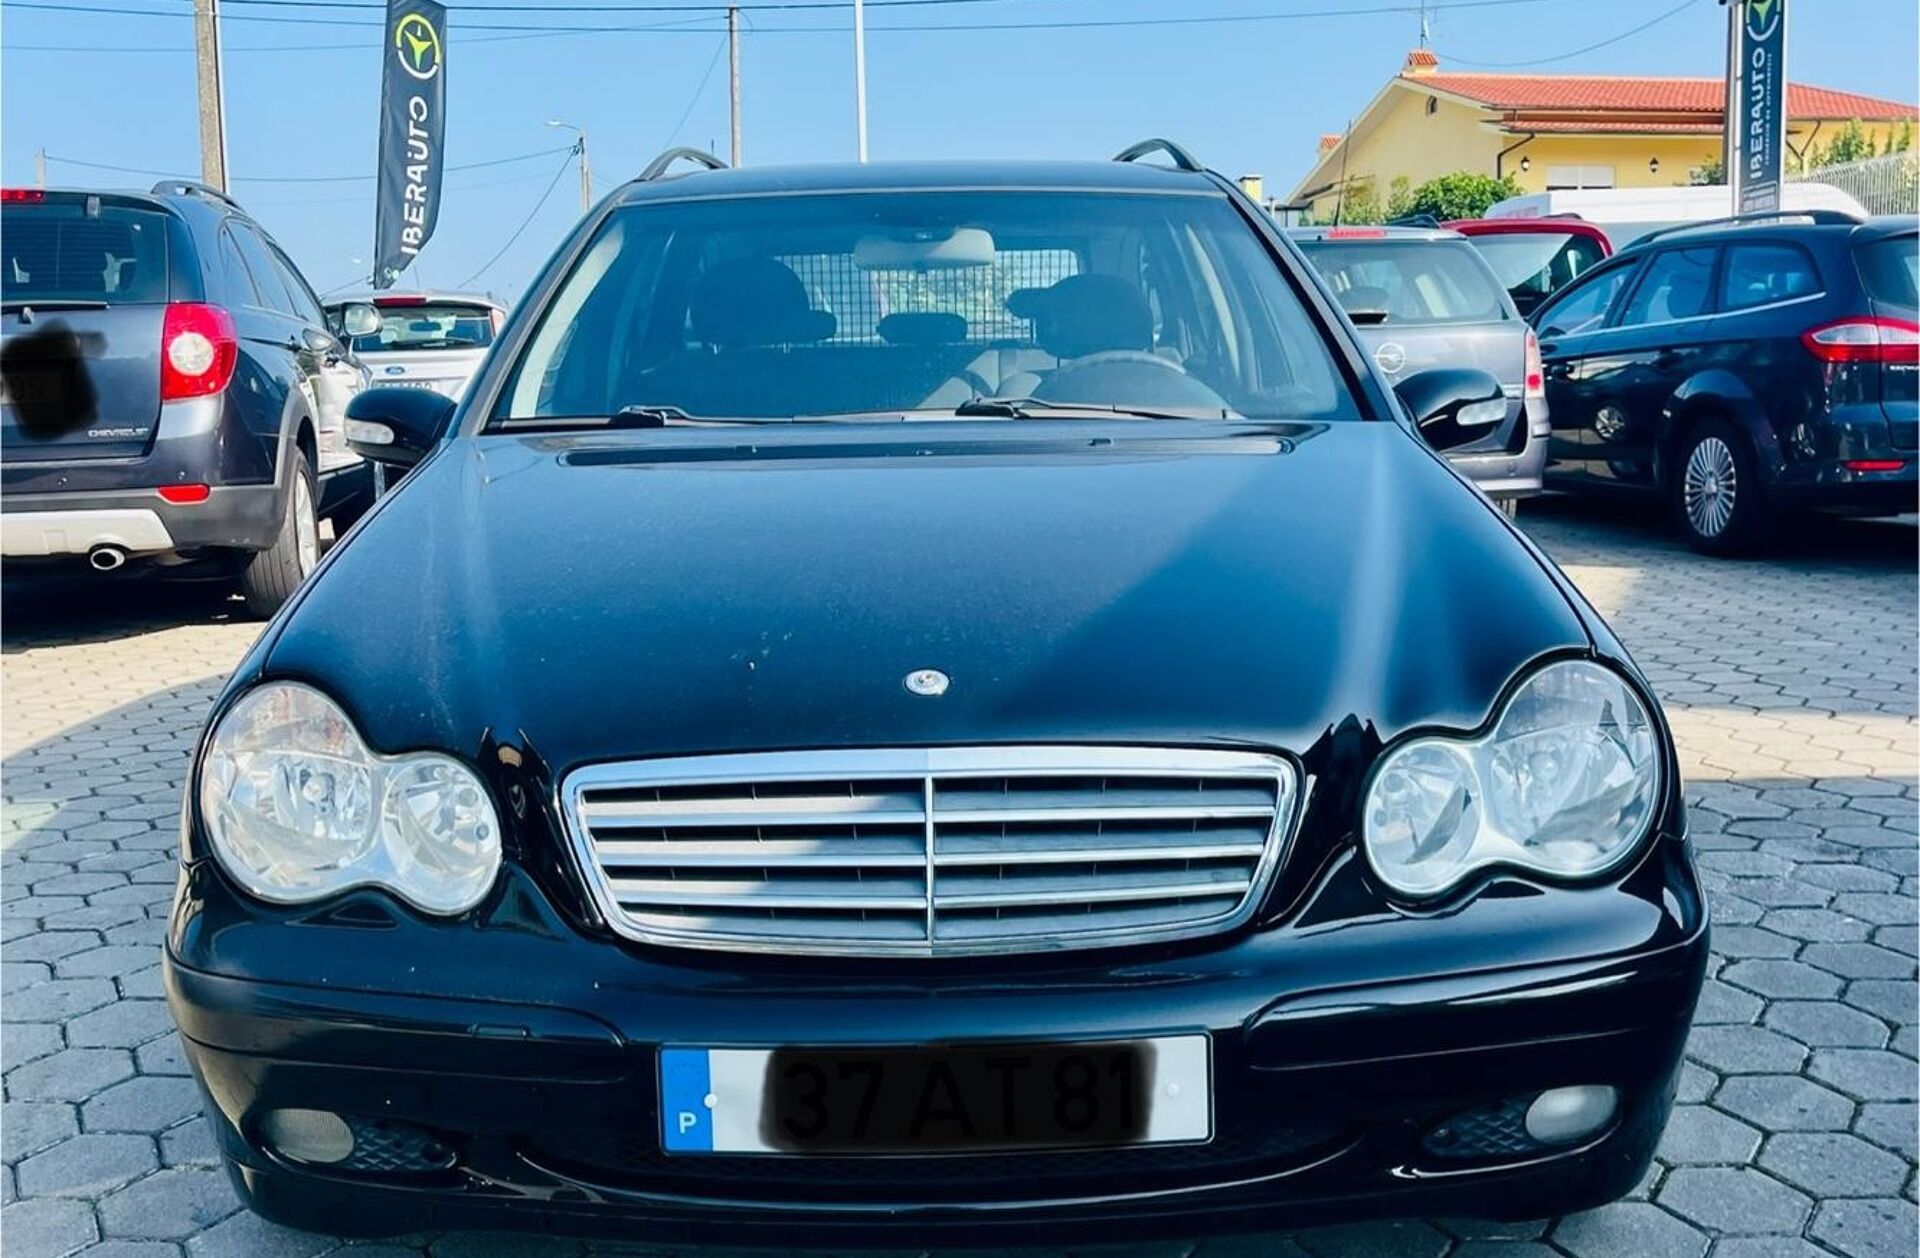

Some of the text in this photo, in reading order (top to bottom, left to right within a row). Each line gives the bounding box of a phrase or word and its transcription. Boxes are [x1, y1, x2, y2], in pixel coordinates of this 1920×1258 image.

[401, 95, 428, 255] IBERAUTO
[1751, 47, 1765, 179] IBERAUTO
[679, 1112, 697, 1134] P
